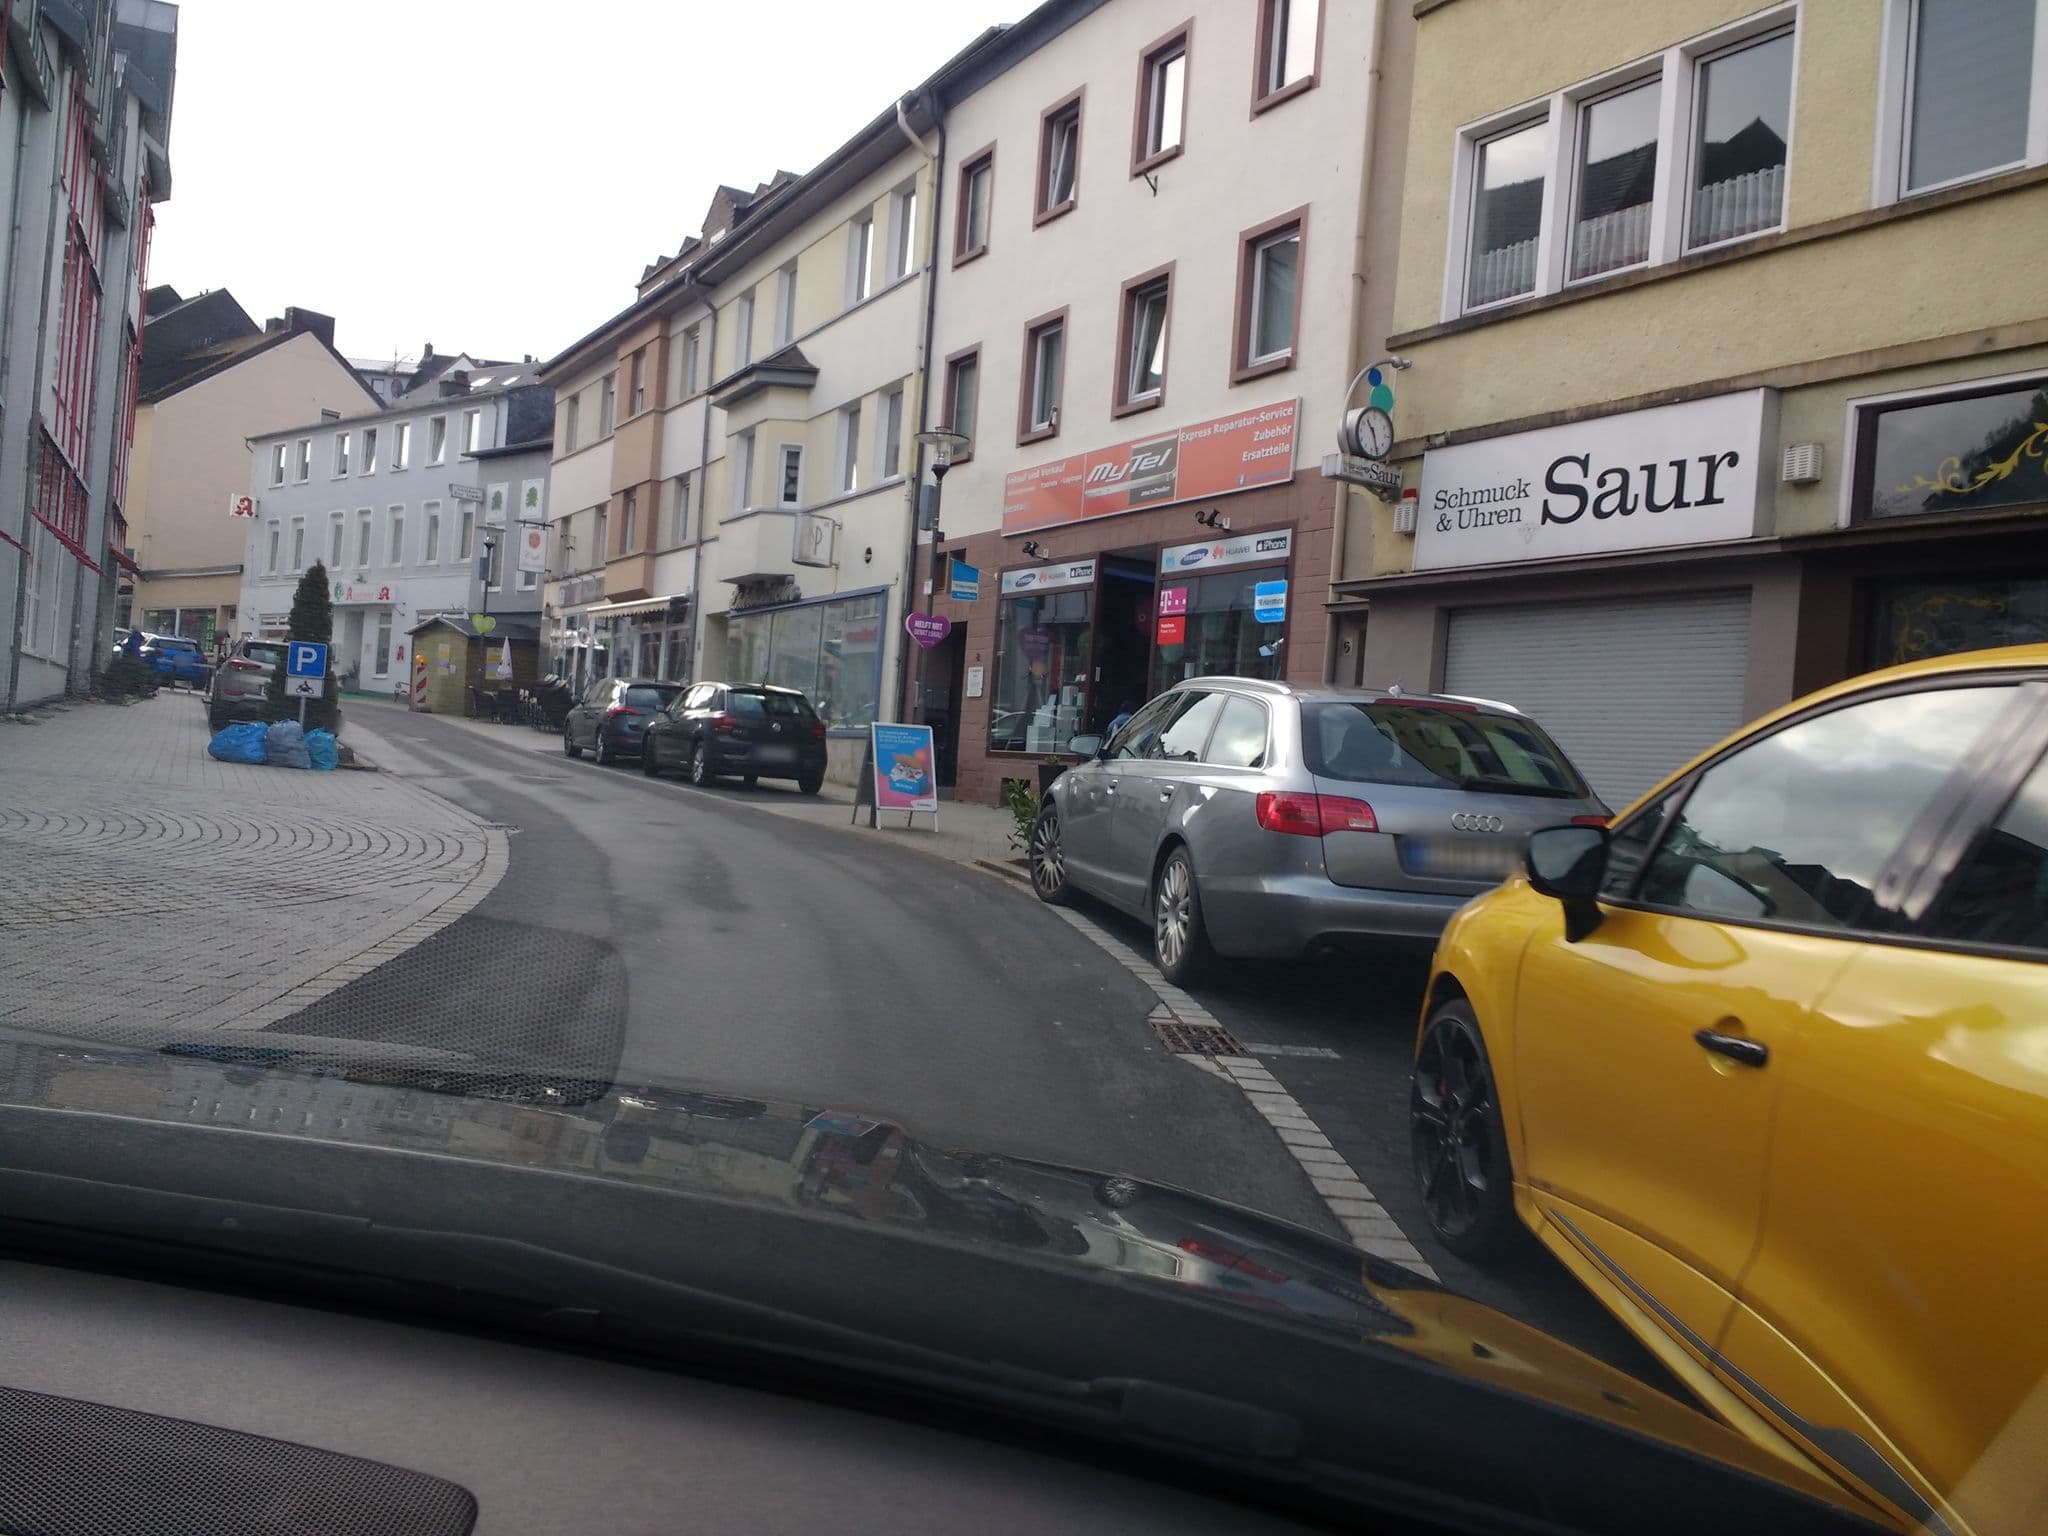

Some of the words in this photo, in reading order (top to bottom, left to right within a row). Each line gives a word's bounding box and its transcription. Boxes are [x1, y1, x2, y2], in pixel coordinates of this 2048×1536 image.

[1180, 427, 1212, 442] Express
[1213, 407, 1294, 434] Reparatur-Service
[1253, 425, 1292, 442] Zubehör
[1242, 443, 1290, 462] Ersatzteile
[1369, 463, 1400, 486] Saur
[1433, 478, 1531, 511] Schmuck
[1540, 451, 1739, 525] Saur
[1435, 515, 1451, 532] &
[1457, 506, 1522, 530] Uhren
[296, 646, 318, 672] P
